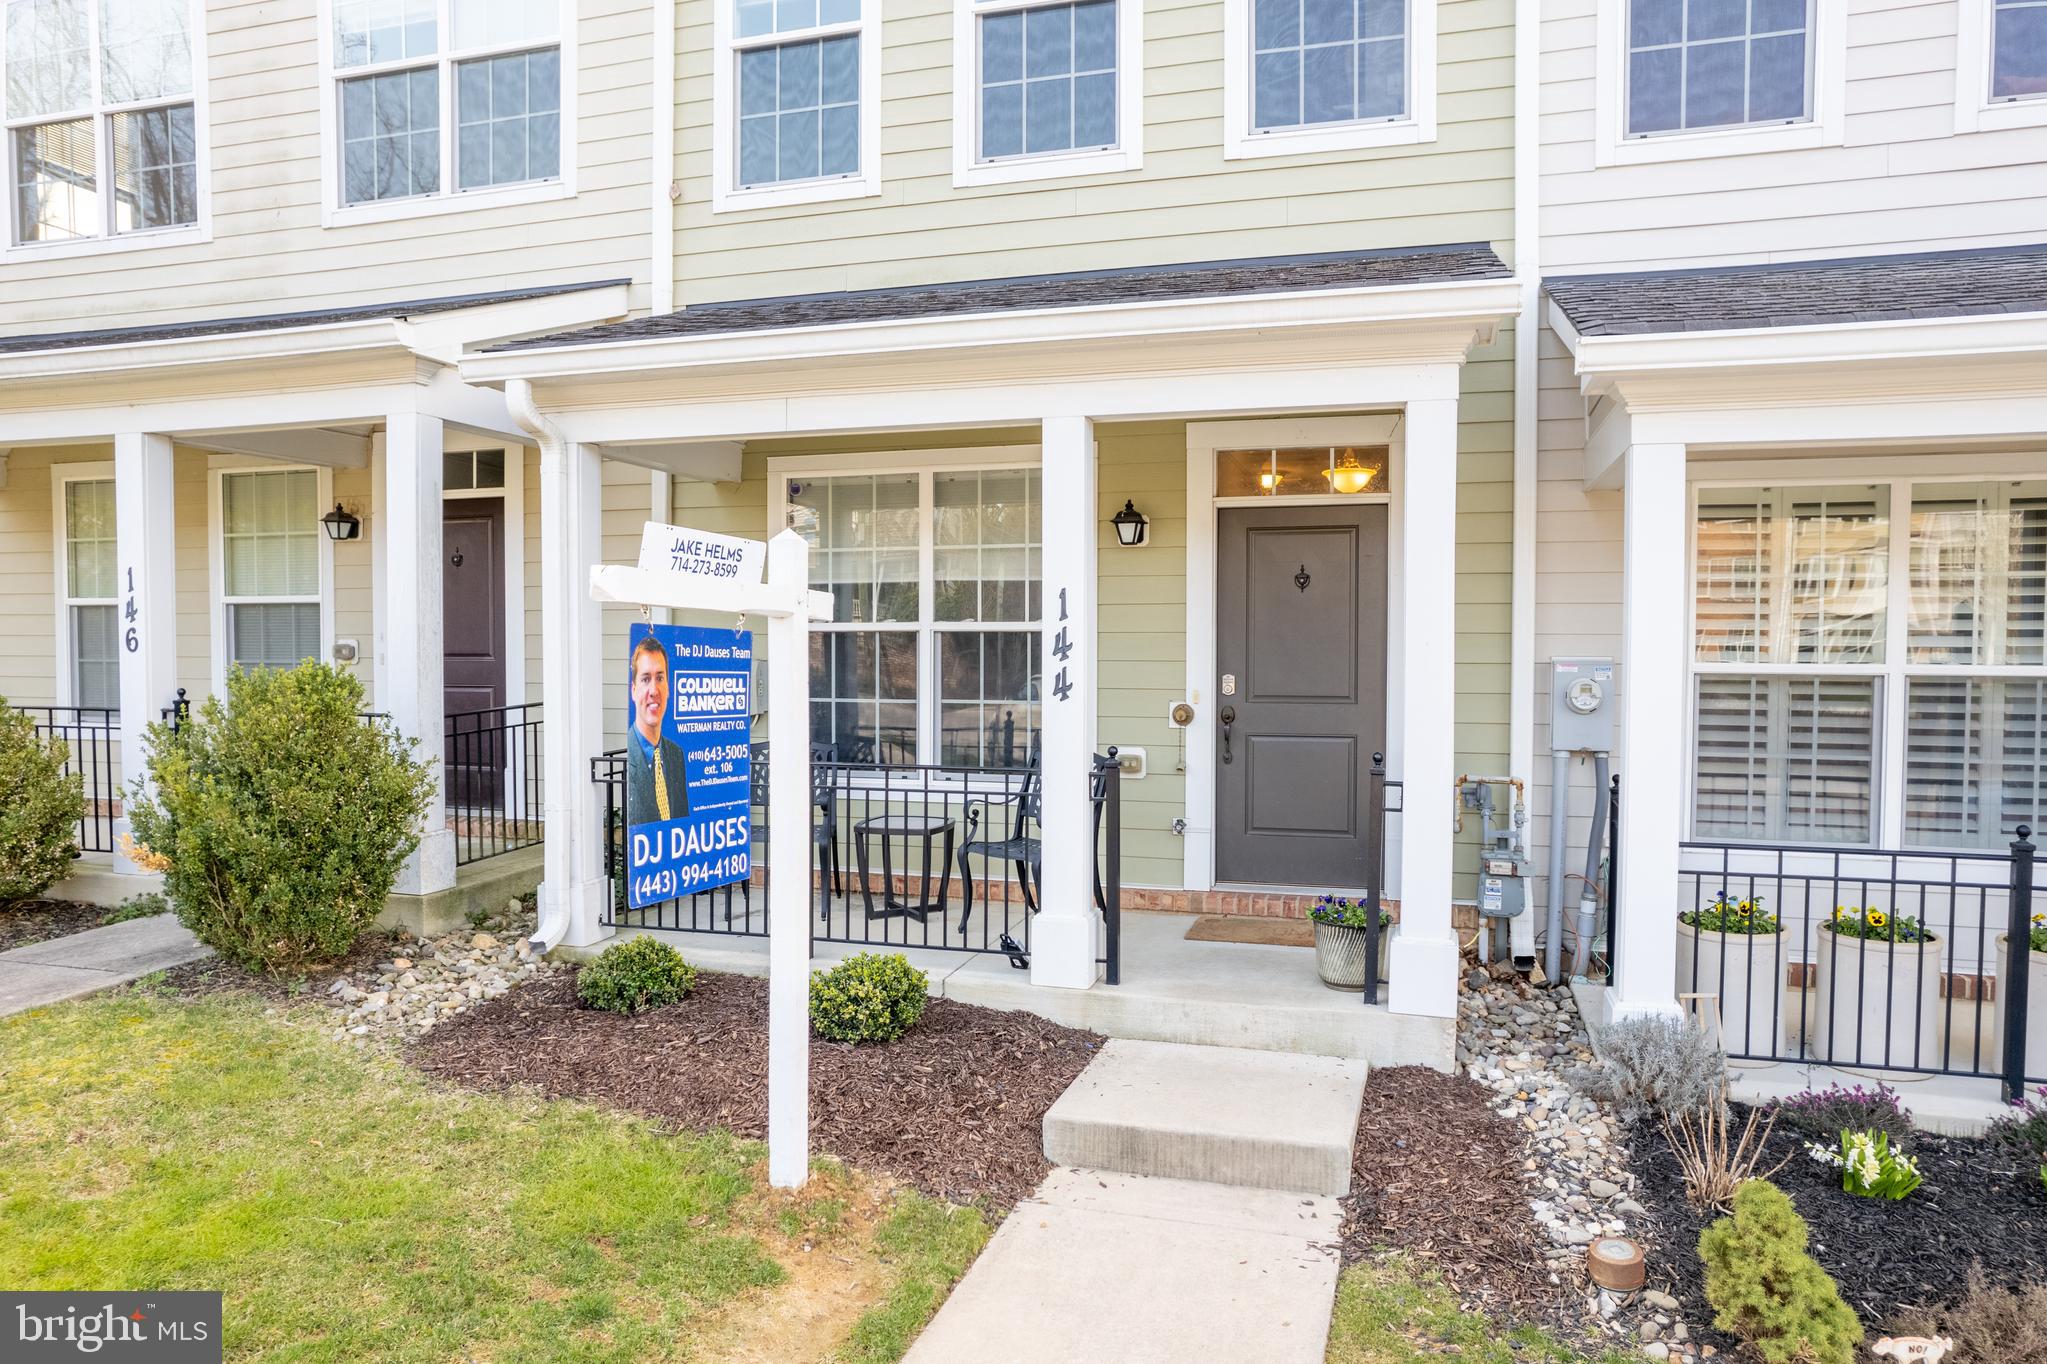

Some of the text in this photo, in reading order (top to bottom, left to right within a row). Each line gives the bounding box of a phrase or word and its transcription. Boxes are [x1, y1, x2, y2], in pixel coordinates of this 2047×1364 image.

[670, 538, 743, 562] JAKE HELMS
[670, 556, 738, 578] 714-273-8599
[125, 566, 138, 652] 146
[675, 643, 751, 659] The DJ Dauses Team
[1052, 587, 1073, 702] 144
[677, 677, 746, 694] COLDWELL
[678, 695, 735, 713] BANKER
[677, 720, 746, 733] WATERMAN REALTY CO.
[704, 762, 733, 774] ext. 106
[634, 815, 748, 867] DJ DAUSES
[635, 853, 747, 904] (443) 994-4180
